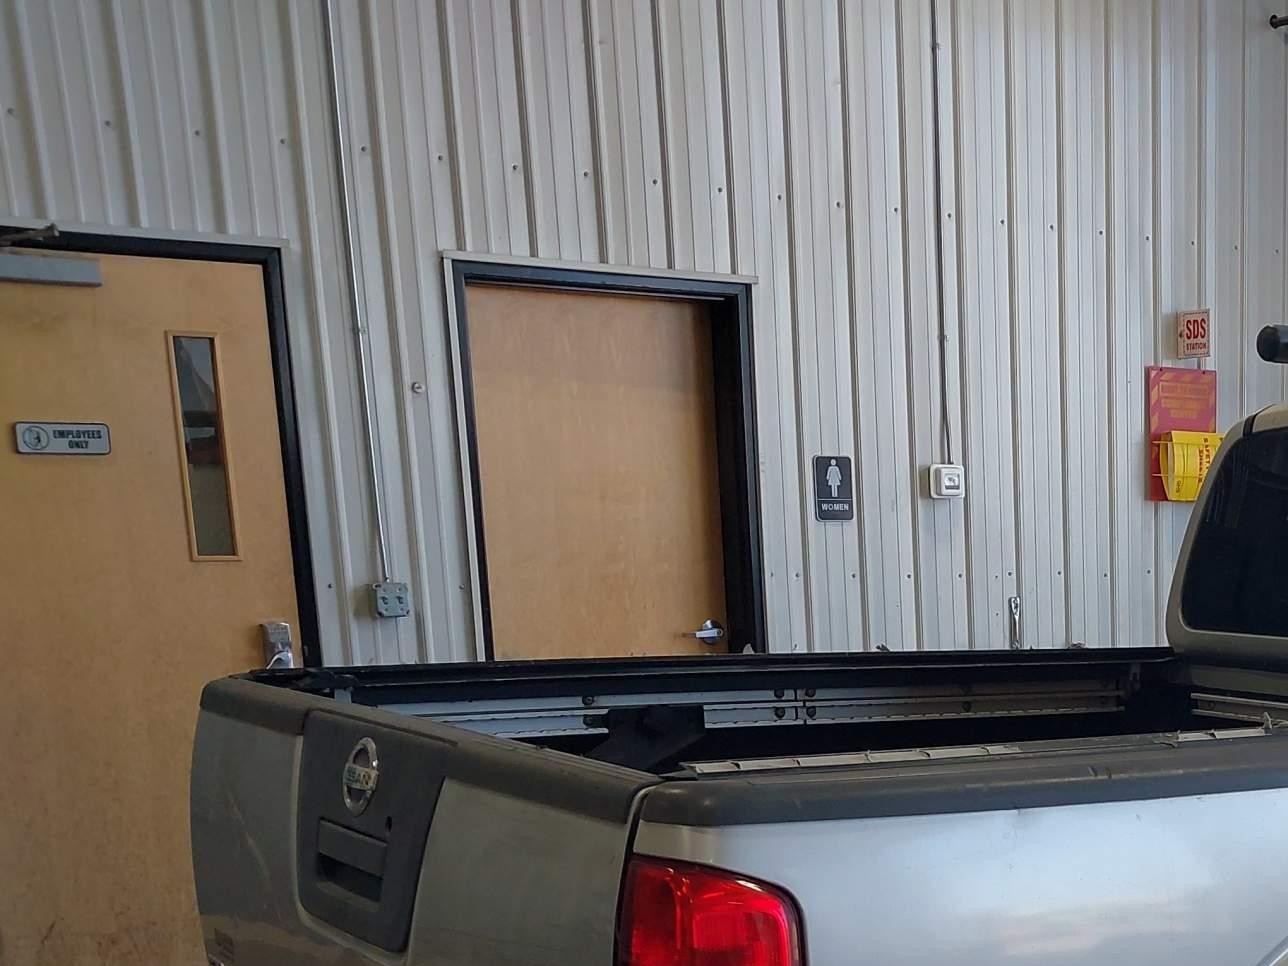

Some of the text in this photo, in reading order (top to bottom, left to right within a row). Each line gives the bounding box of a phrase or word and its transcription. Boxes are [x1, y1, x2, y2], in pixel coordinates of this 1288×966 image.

[1185, 318, 1207, 340] SDS
[1186, 341, 1207, 351] STATION
[53, 429, 102, 440] EMPLOYEES
[68, 440, 89, 449] ONLY
[821, 503, 849, 511] WOMEN
